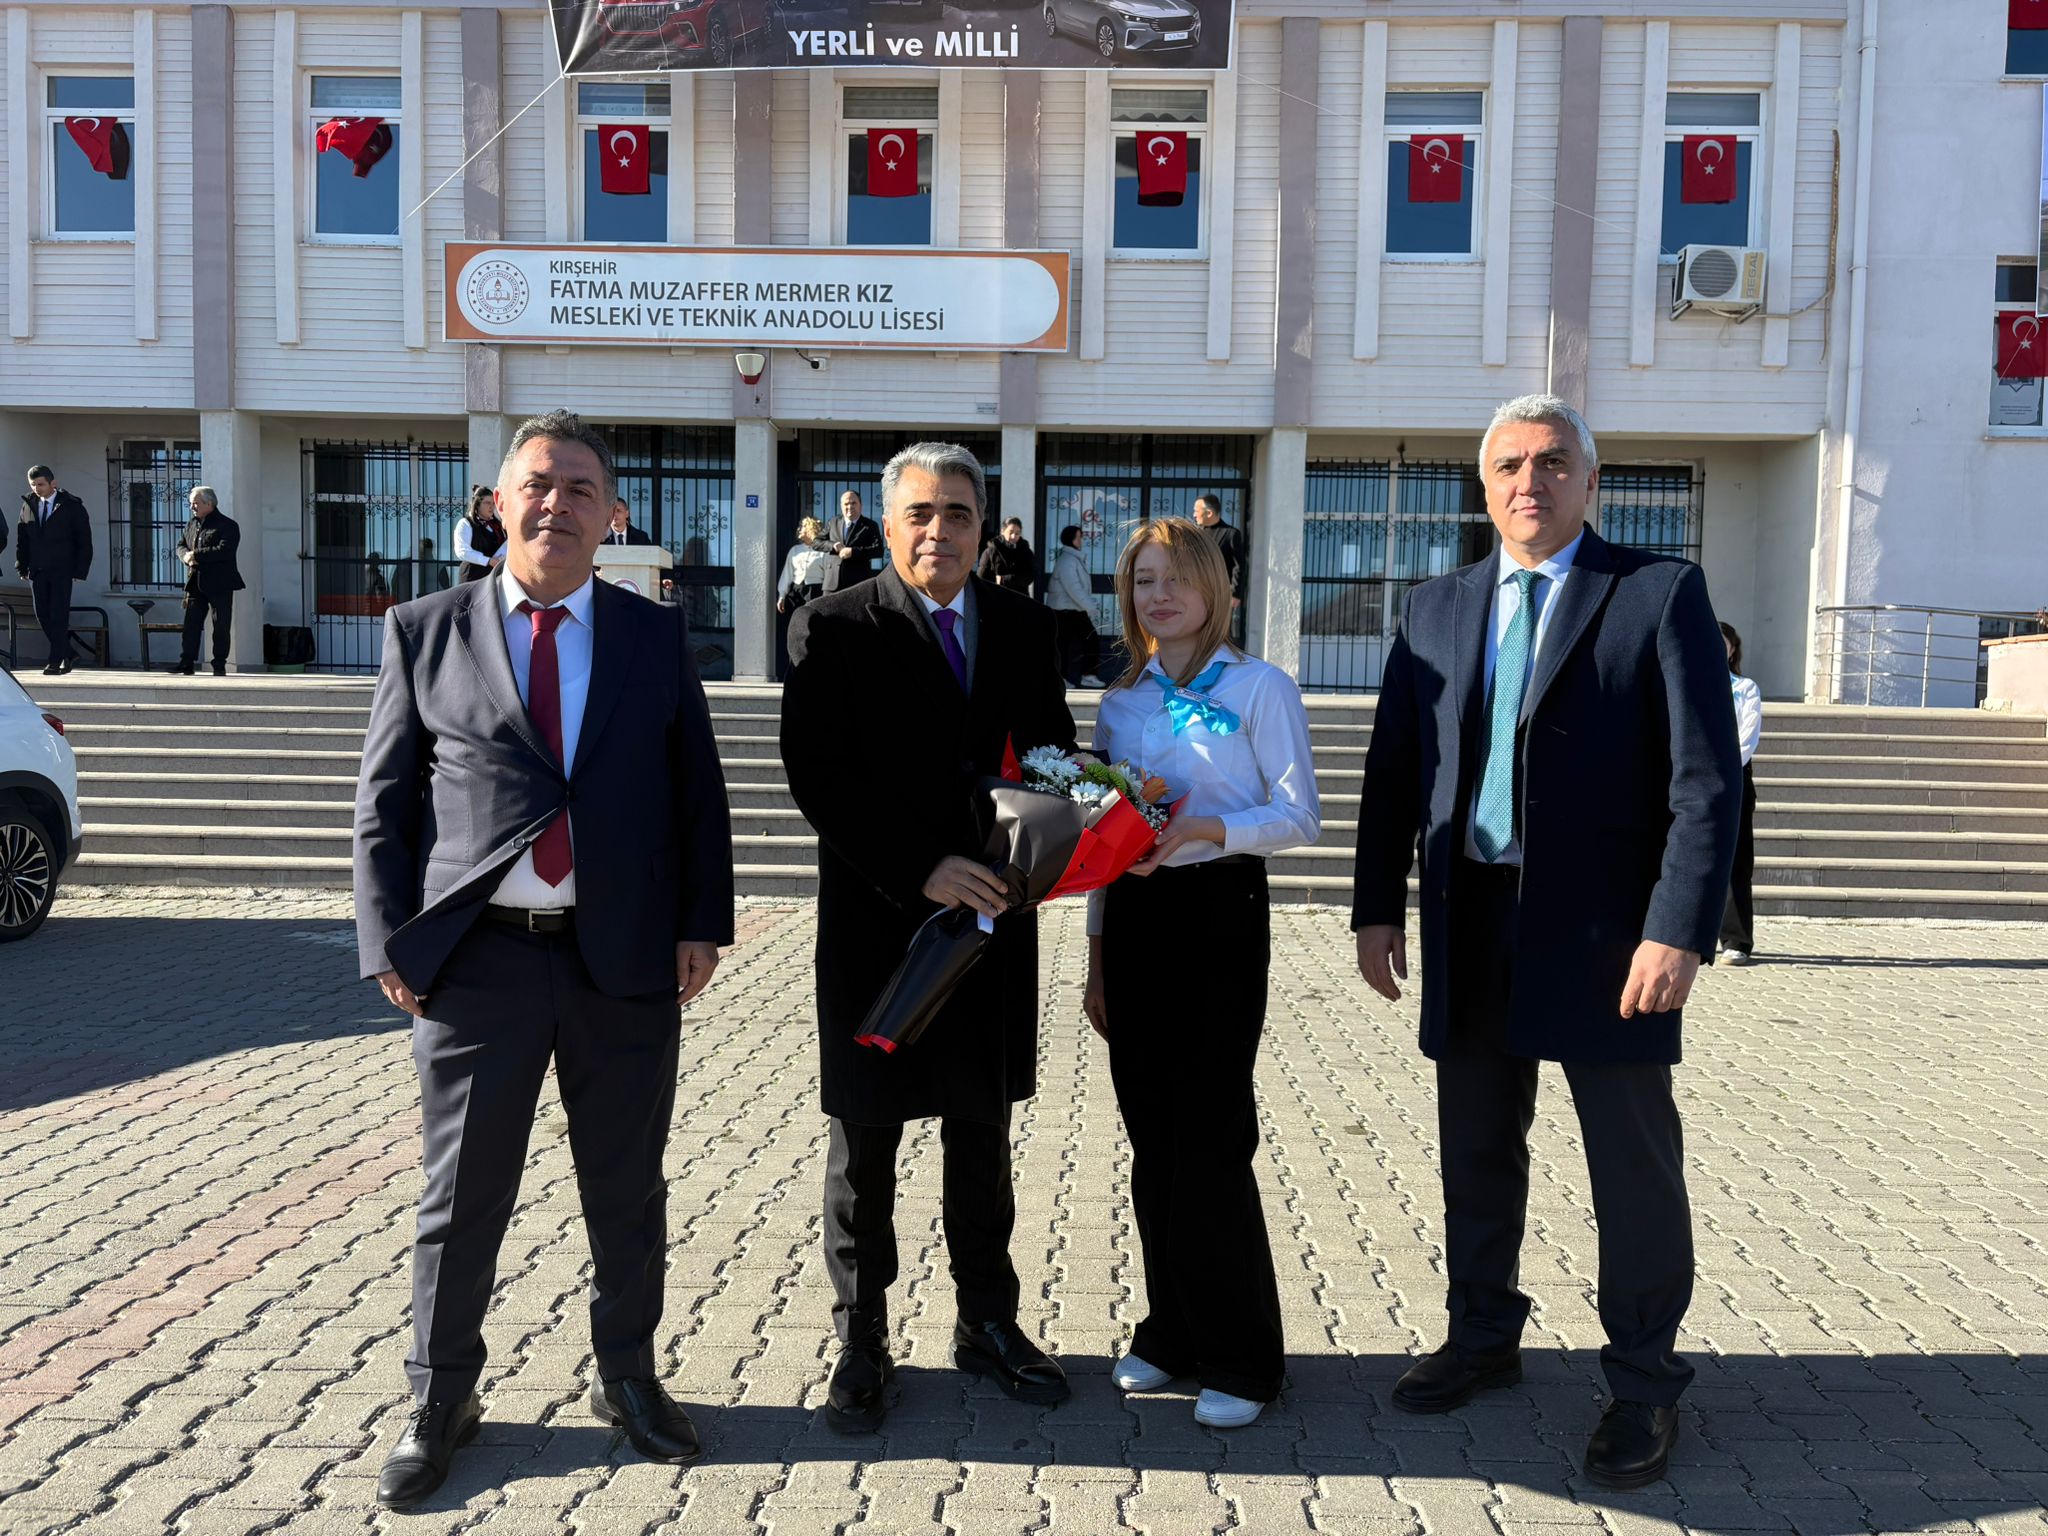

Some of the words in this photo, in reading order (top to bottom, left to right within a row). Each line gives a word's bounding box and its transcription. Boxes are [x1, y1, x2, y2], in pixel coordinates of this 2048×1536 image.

[788, 22, 875, 56] YERLİ
[886, 37, 924, 56] ve
[934, 23, 1019, 57] MİLLİ
[550, 259, 617, 277] KIRŞEHİR
[550, 280, 623, 299] FATMA
[630, 281, 749, 301] MUZAFFER
[755, 283, 850, 303] MERMER
[857, 284, 894, 303] KIZ
[550, 303, 641, 326] MESLEKİ
[647, 308, 674, 326] VE
[679, 305, 758, 328] TEKNİK
[763, 309, 874, 330] ANADOLU
[881, 307, 944, 331] LİSESİ
